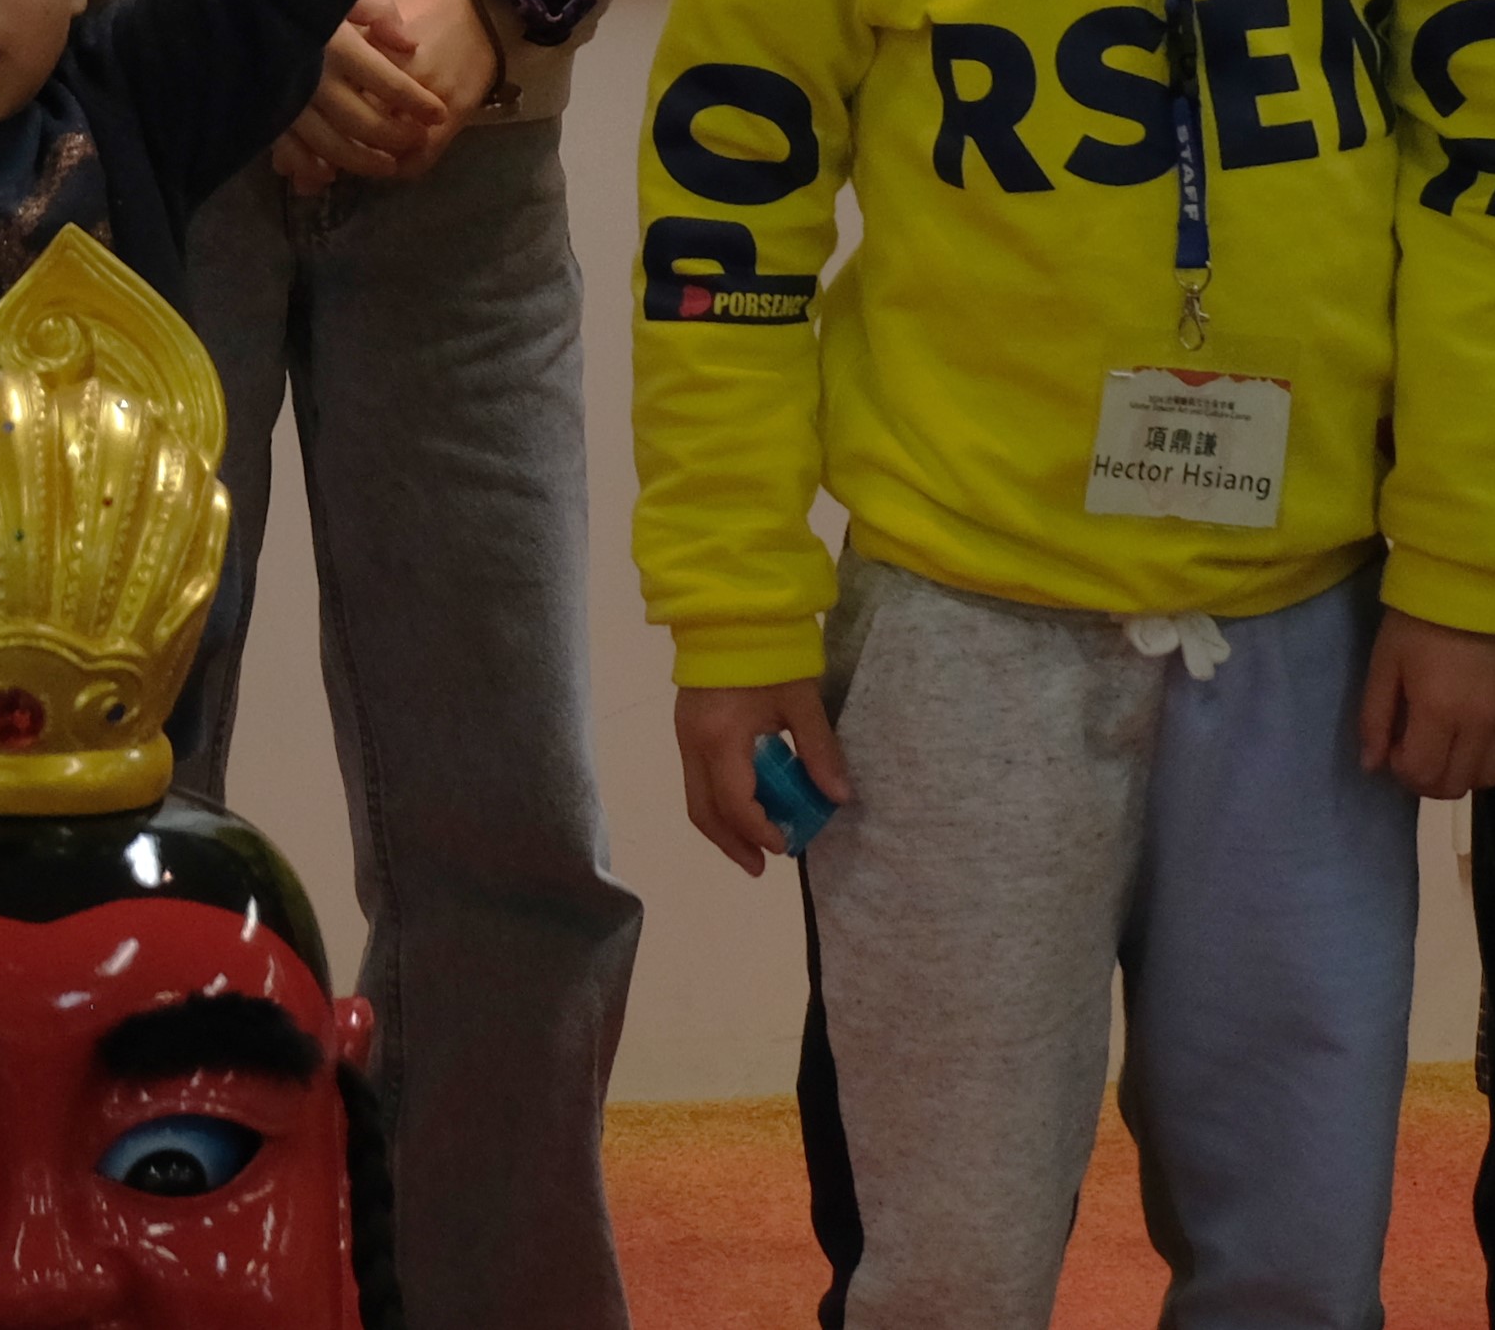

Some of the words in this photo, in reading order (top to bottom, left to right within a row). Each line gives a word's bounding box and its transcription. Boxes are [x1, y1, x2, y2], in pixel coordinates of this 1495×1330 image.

[1174, 123, 1201, 222] STAFF
[1092, 454, 1174, 483] Hector
[1182, 462, 1272, 500] Hsiang
